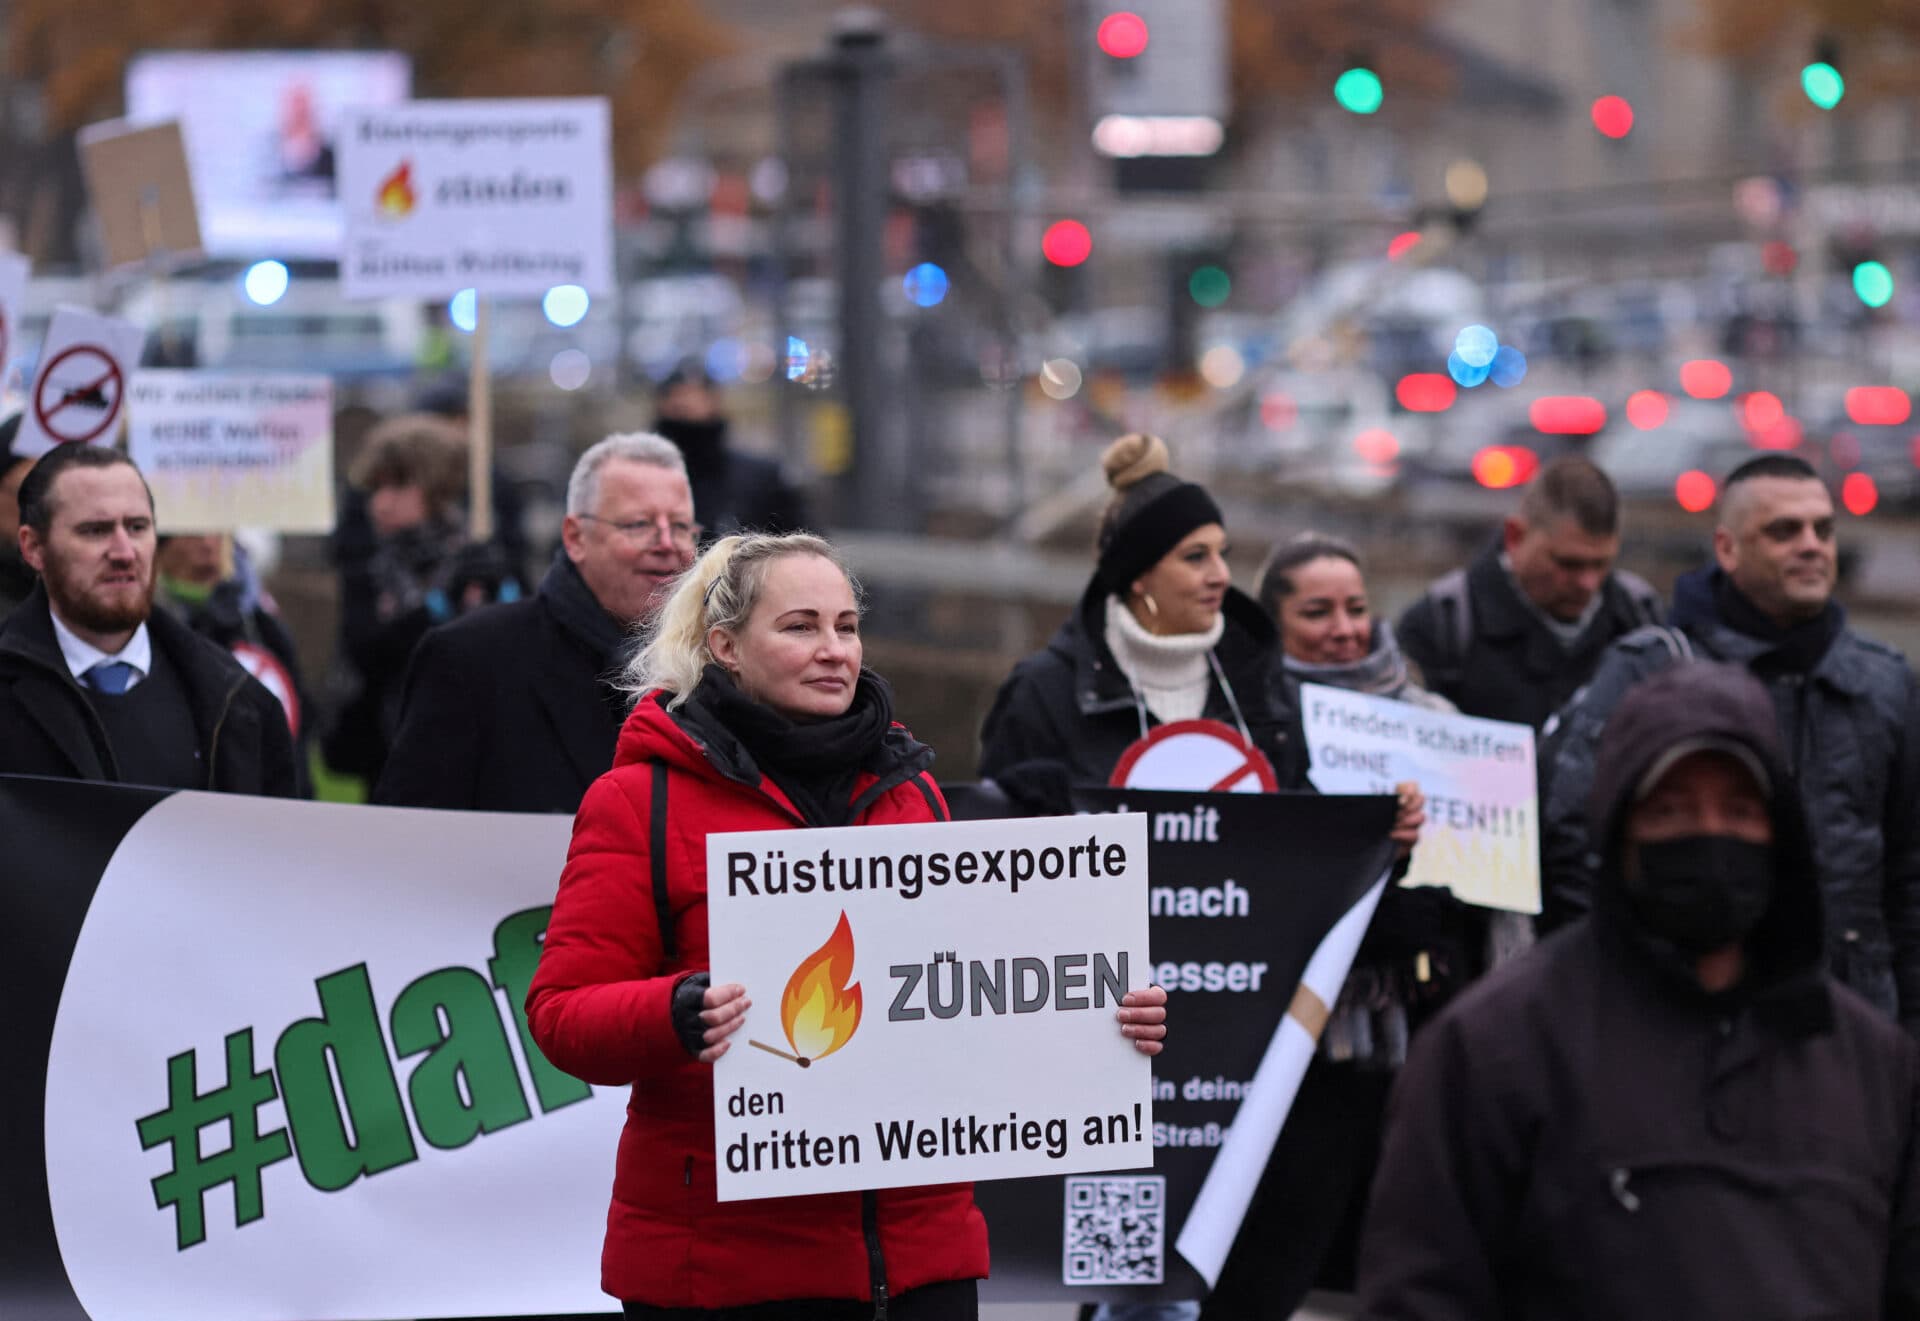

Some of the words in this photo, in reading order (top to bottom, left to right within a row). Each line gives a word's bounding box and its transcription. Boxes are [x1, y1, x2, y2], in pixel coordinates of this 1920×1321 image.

[1312, 700, 1409, 742] Frieden
[1414, 726, 1526, 763] schaffen
[1319, 743, 1393, 779] OHNE
[1154, 805, 1220, 842] mit
[727, 834, 1128, 900] Rüstungsexporte
[1150, 879, 1250, 917] nach
[887, 950, 1130, 1023] ZÜNDEN
[1149, 960, 1268, 992] esser
[727, 1086, 785, 1118] den
[725, 1131, 861, 1174] dritten
[875, 1112, 1069, 1160] Weltkrieg
[1083, 1102, 1144, 1146] an!
